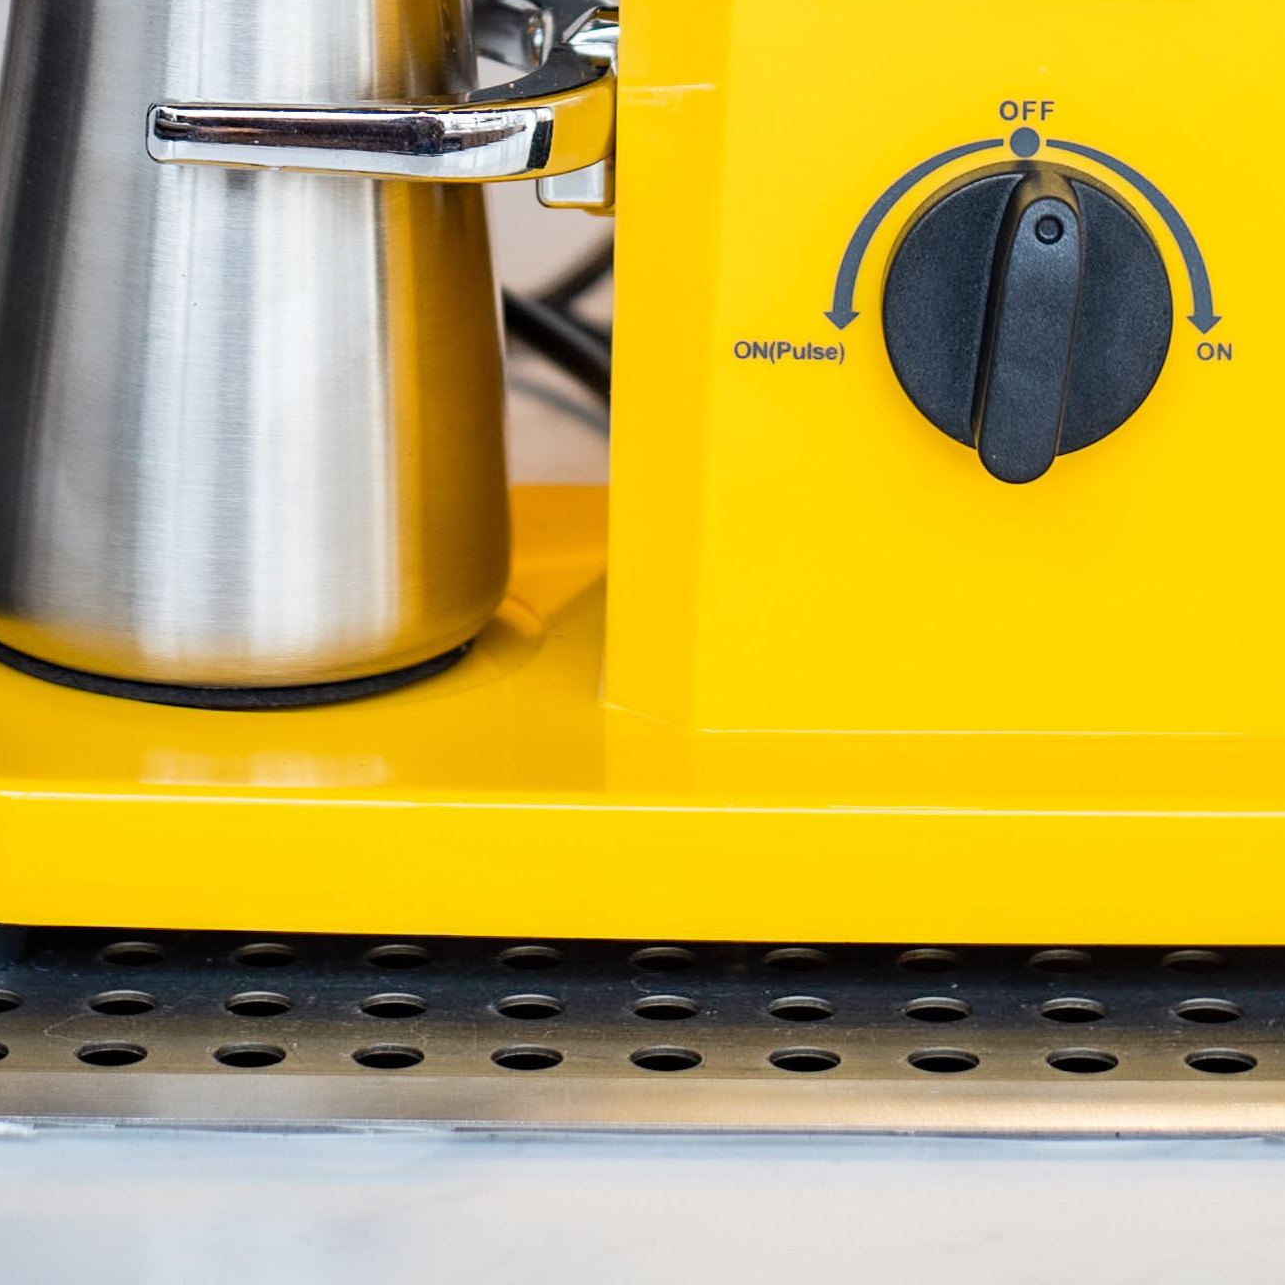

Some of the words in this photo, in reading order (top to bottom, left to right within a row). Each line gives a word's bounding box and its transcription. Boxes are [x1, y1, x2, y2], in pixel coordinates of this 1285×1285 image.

[999, 100, 1055, 121] OFF
[733, 340, 845, 365] ON(Pulse)
[1196, 342, 1232, 361] ON
